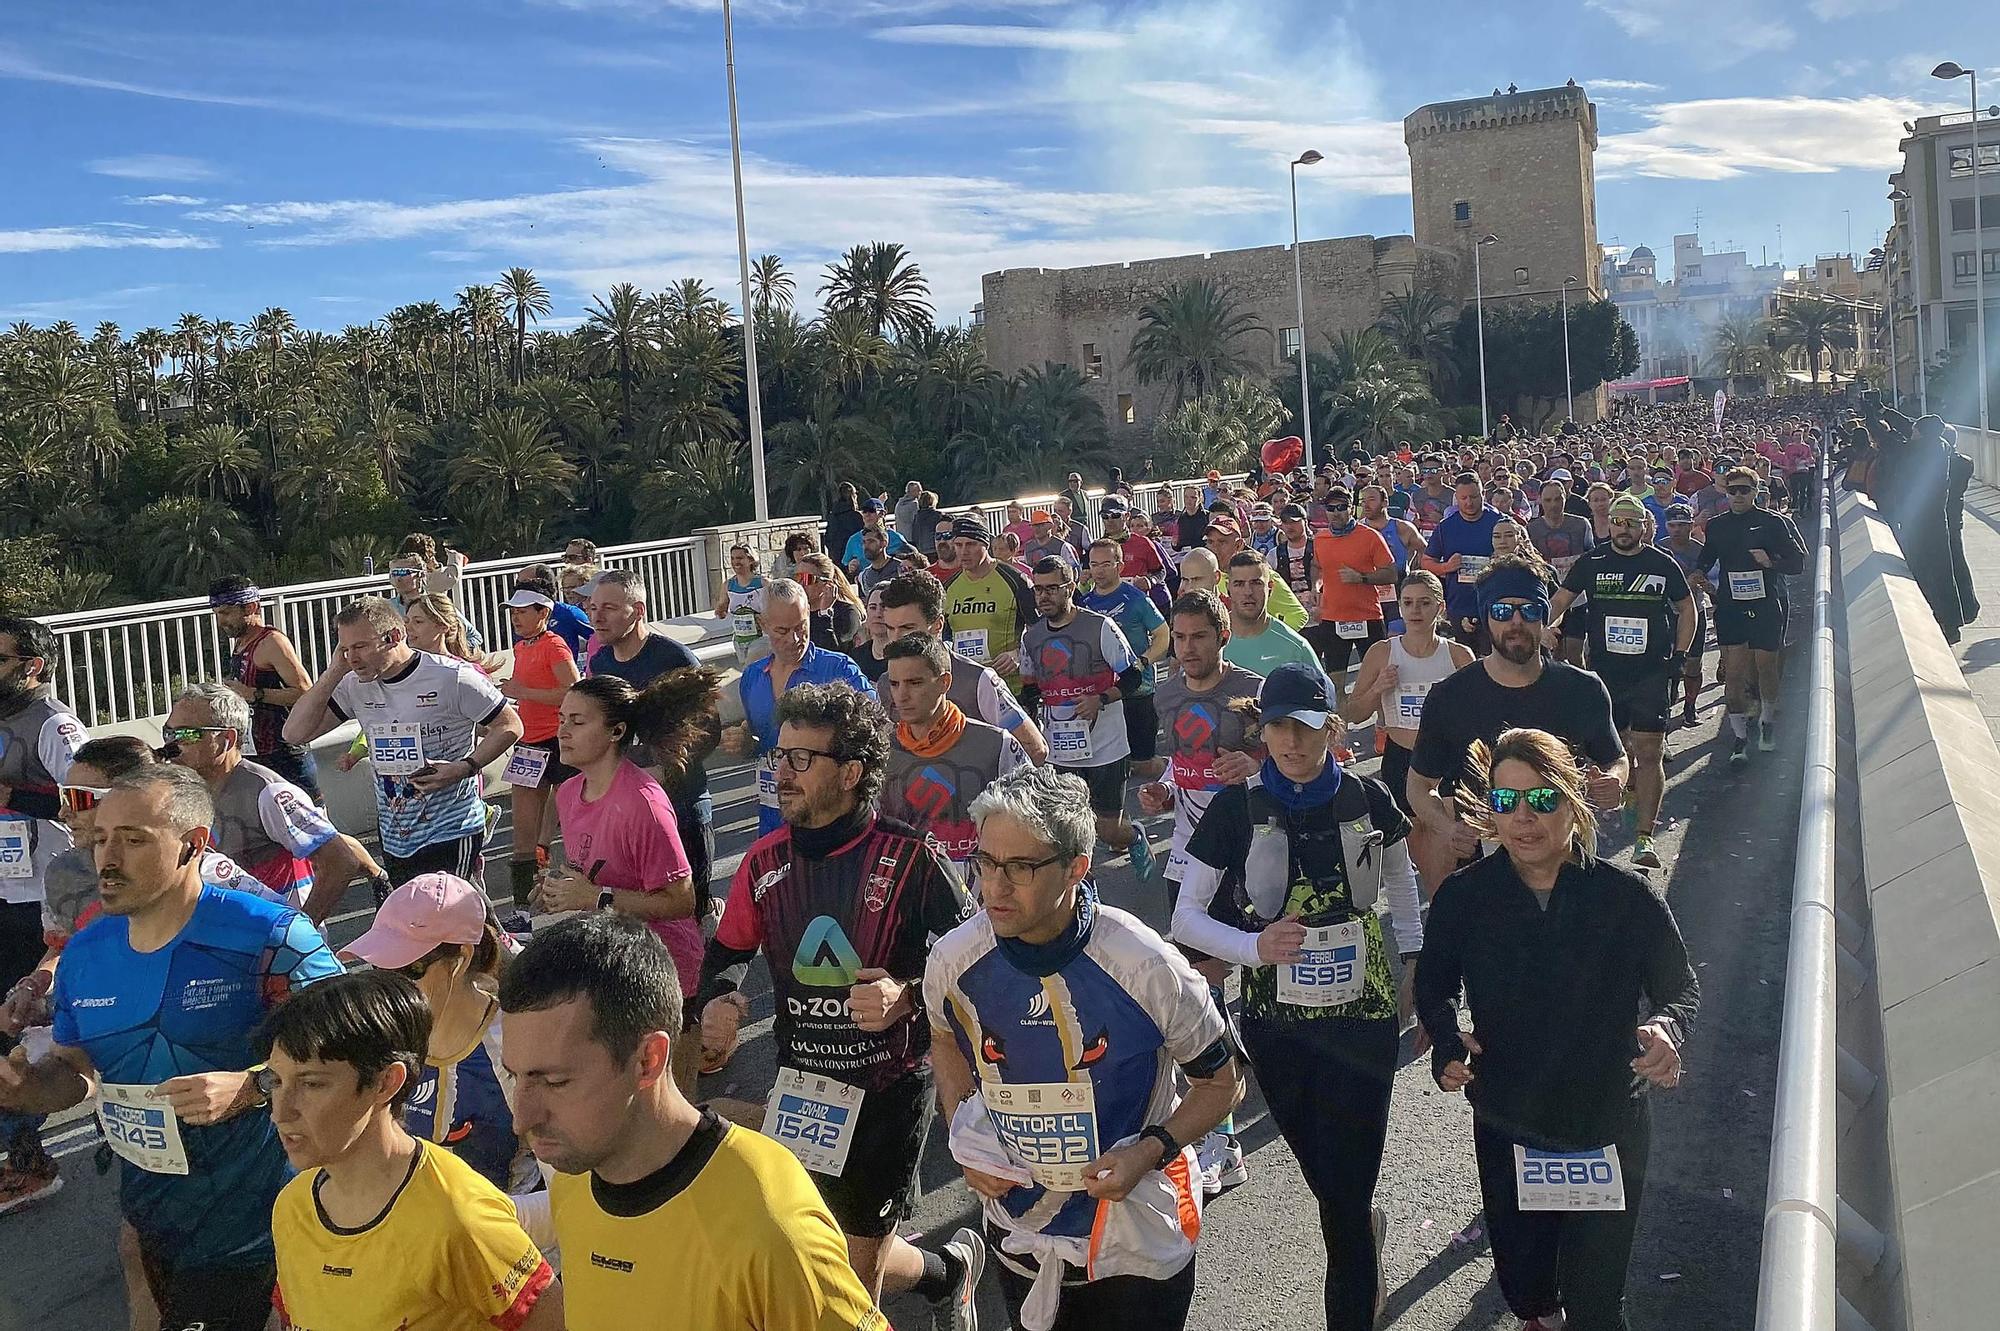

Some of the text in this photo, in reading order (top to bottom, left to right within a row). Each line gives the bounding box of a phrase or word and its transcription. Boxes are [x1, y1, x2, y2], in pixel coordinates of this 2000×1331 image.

[1596, 573, 1624, 581] ELCHE
[1608, 634, 1644, 645] 2405
[1401, 705, 1422, 718] 20
[1053, 739, 1088, 751] 2250
[375, 748, 419, 762] 2546
[508, 763, 541, 778] 2073
[760, 780, 777, 794] 20
[0, 849, 24, 863] 67
[1290, 963, 1353, 986] 1593
[824, 1050, 892, 1071] CONSTRUCTORA
[994, 1112, 1086, 1133] VICTOR CL
[105, 1117, 168, 1150] 2143
[775, 1113, 841, 1150] 1542
[1522, 1160, 1614, 1185] 2680
